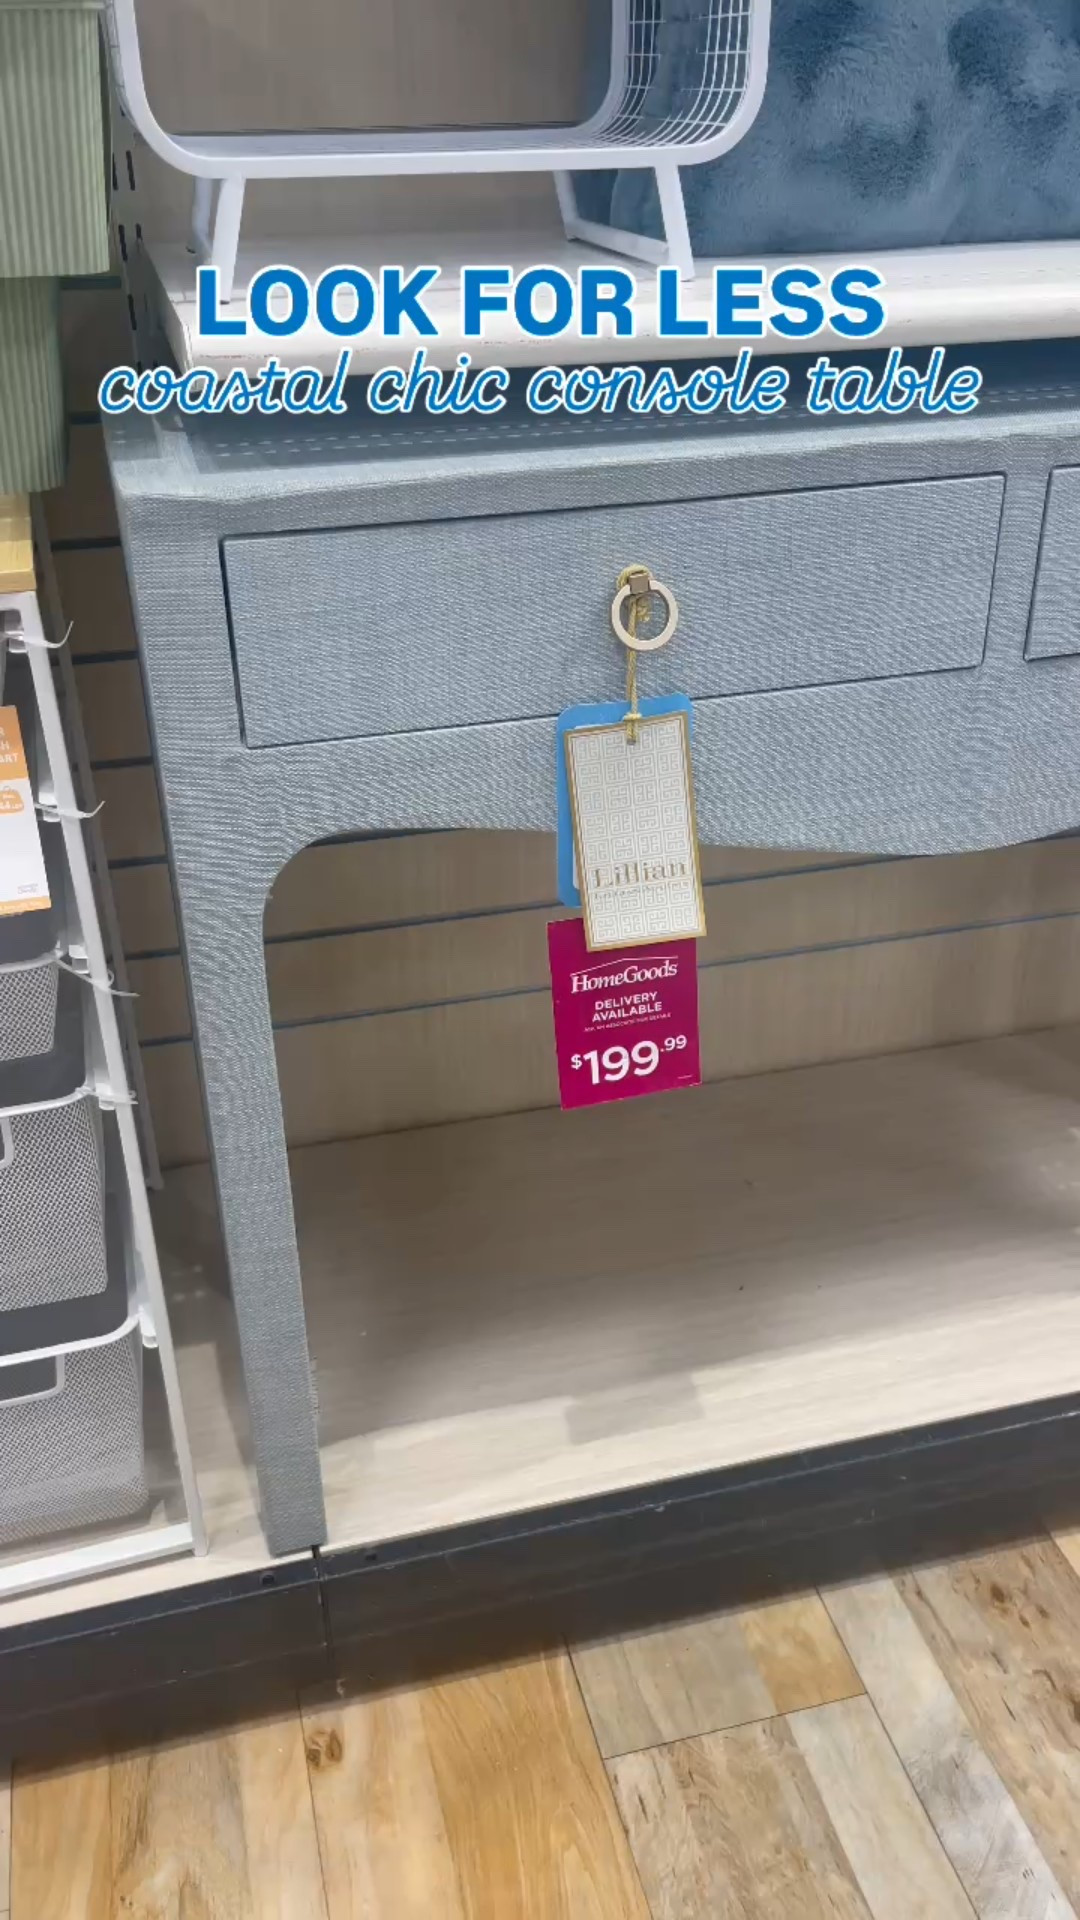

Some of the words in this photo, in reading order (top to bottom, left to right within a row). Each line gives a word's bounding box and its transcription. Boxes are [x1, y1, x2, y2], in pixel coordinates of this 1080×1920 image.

[594, 862, 686, 888] Lillian
[570, 960, 678, 994] HomeGoods
[592, 1001, 662, 1023] AVAILABLE
[595, 991, 658, 1011] DELIVERY
